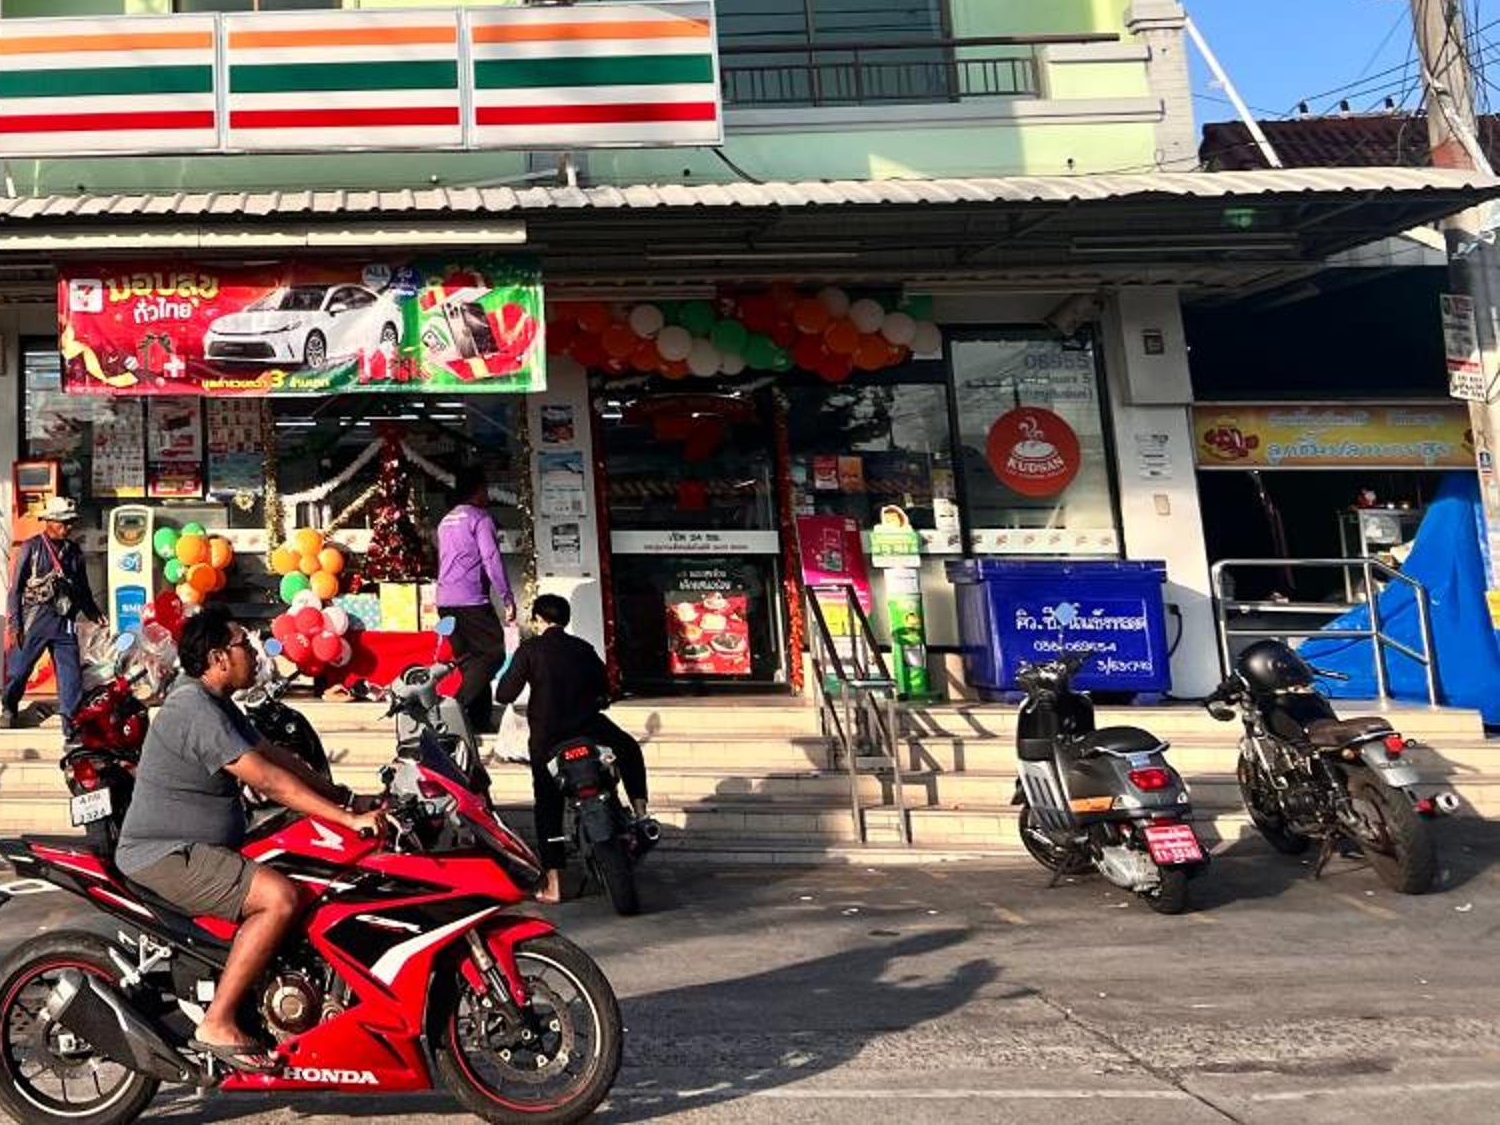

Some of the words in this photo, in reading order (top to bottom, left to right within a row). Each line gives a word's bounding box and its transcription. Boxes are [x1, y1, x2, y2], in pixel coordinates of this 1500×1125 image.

[134, 296, 193, 323] ทั่วไทย
[271, 369, 285, 388] 3
[283, 1067, 380, 1084] HONDA
